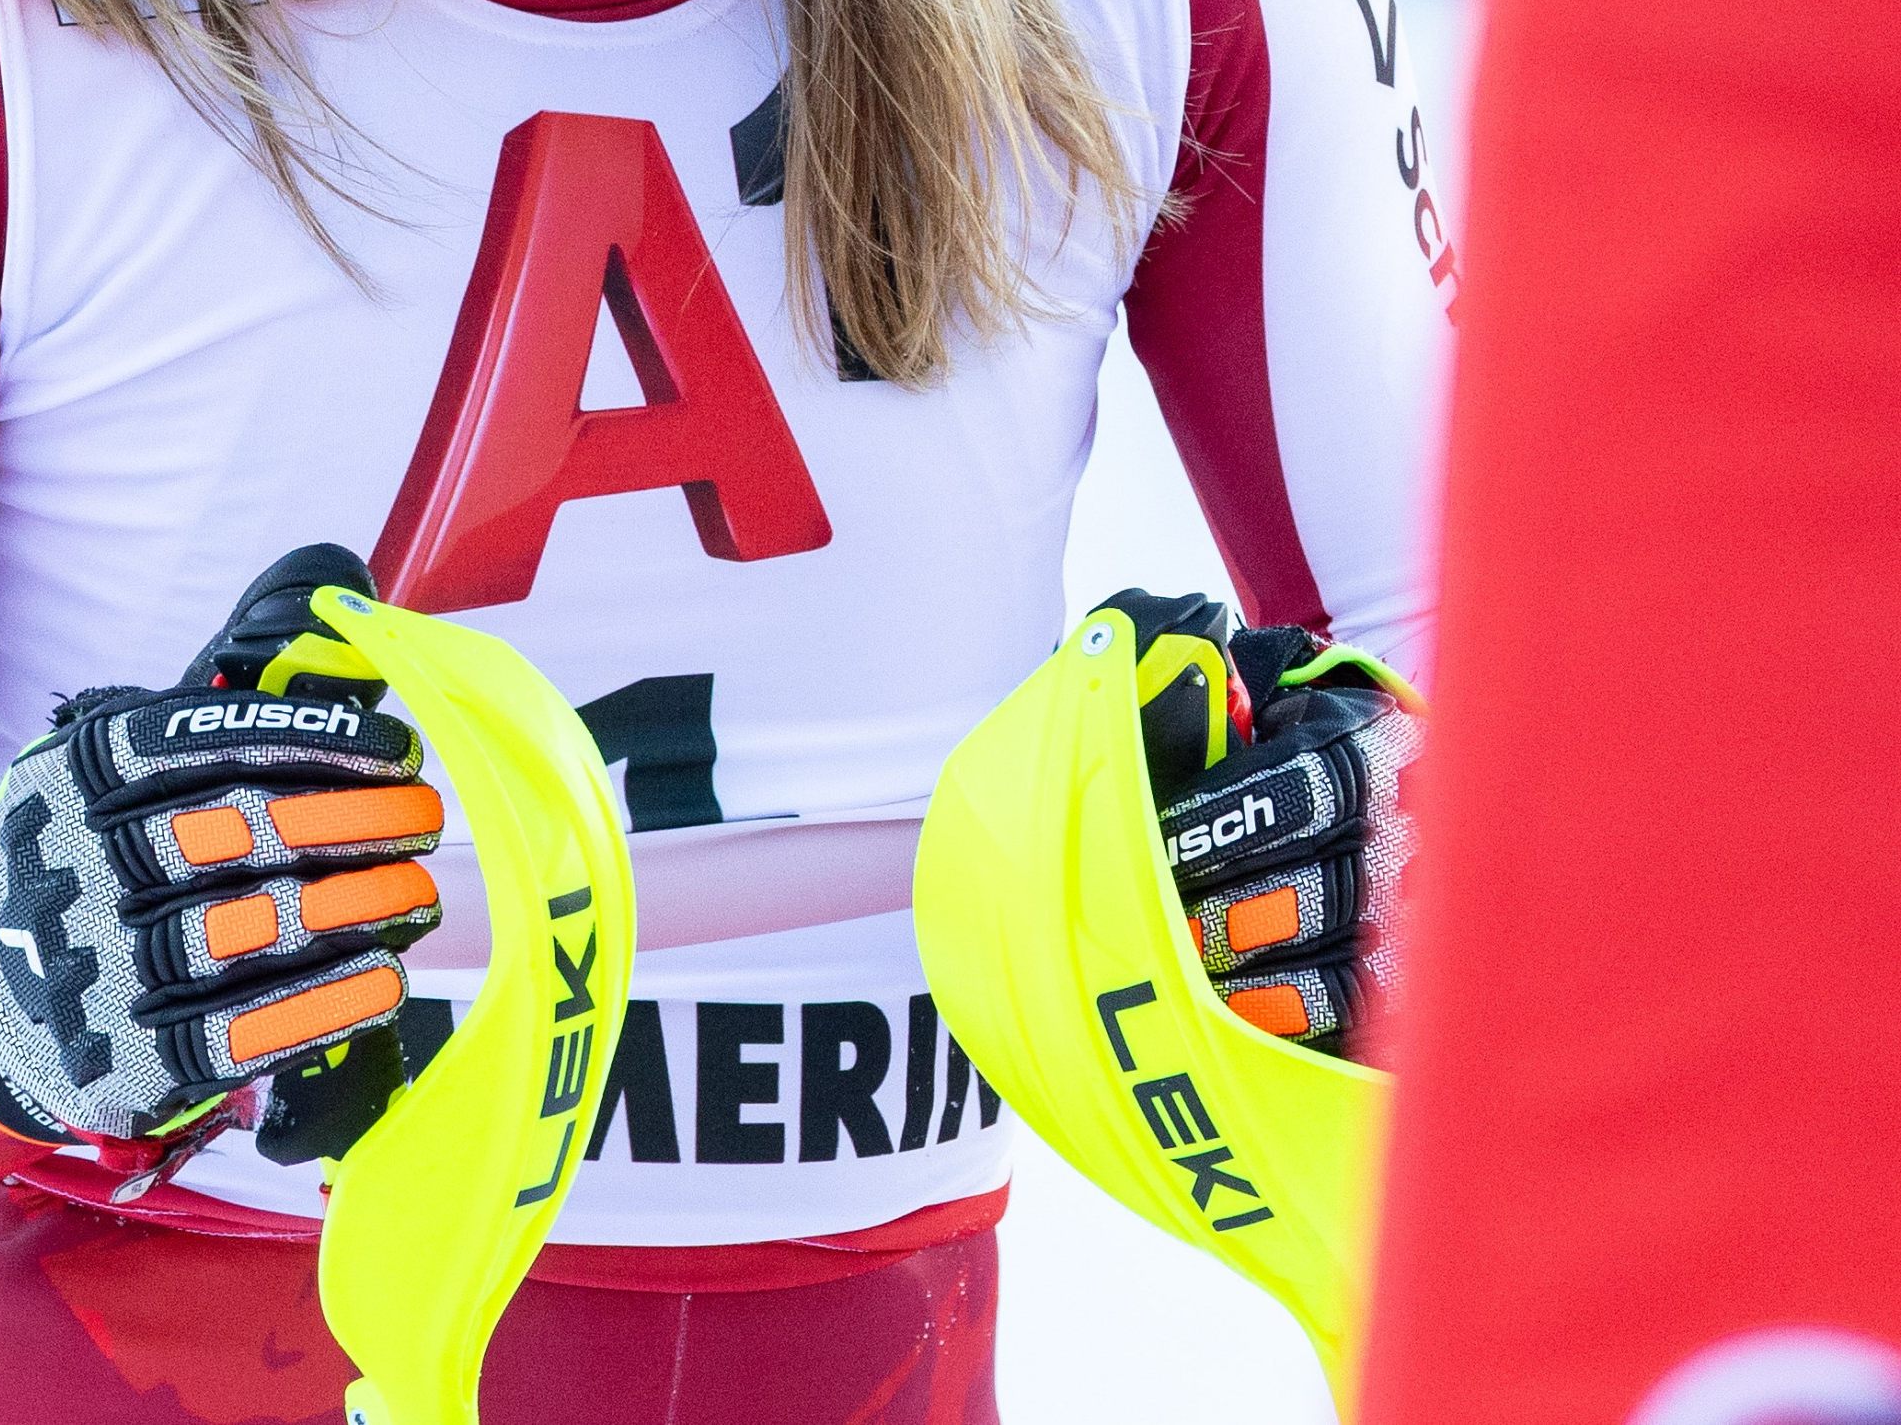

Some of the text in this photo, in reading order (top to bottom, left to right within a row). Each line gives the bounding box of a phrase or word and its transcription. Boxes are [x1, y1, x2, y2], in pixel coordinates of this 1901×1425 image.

[165, 702, 361, 738] reusch
[515, 886, 597, 1208] LEKI
[1096, 979, 1275, 1233] LEKI
